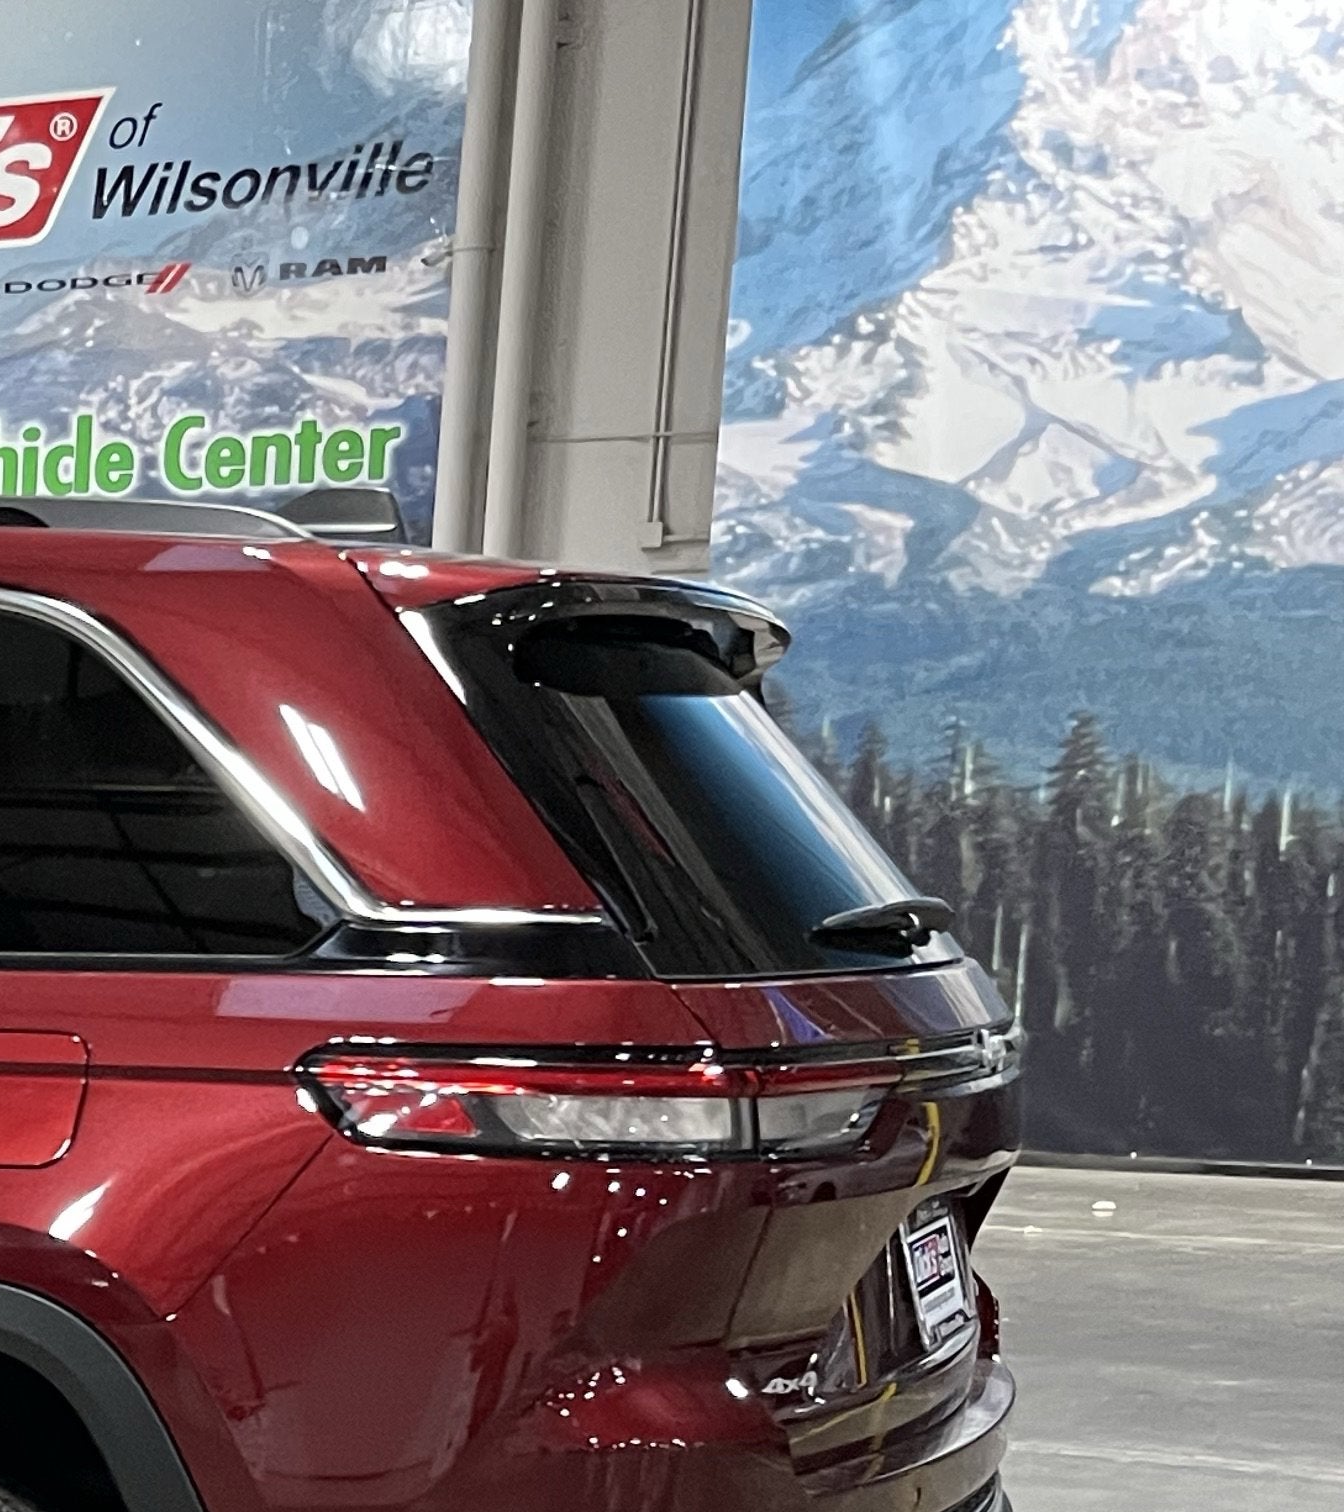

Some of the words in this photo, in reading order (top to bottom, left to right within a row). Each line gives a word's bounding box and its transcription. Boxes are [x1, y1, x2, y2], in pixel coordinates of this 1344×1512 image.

[109, 102, 163, 150] of
[92, 140, 435, 219] Wilsonville
[279, 256, 387, 281] RAM
[164, 415, 402, 490] Center
